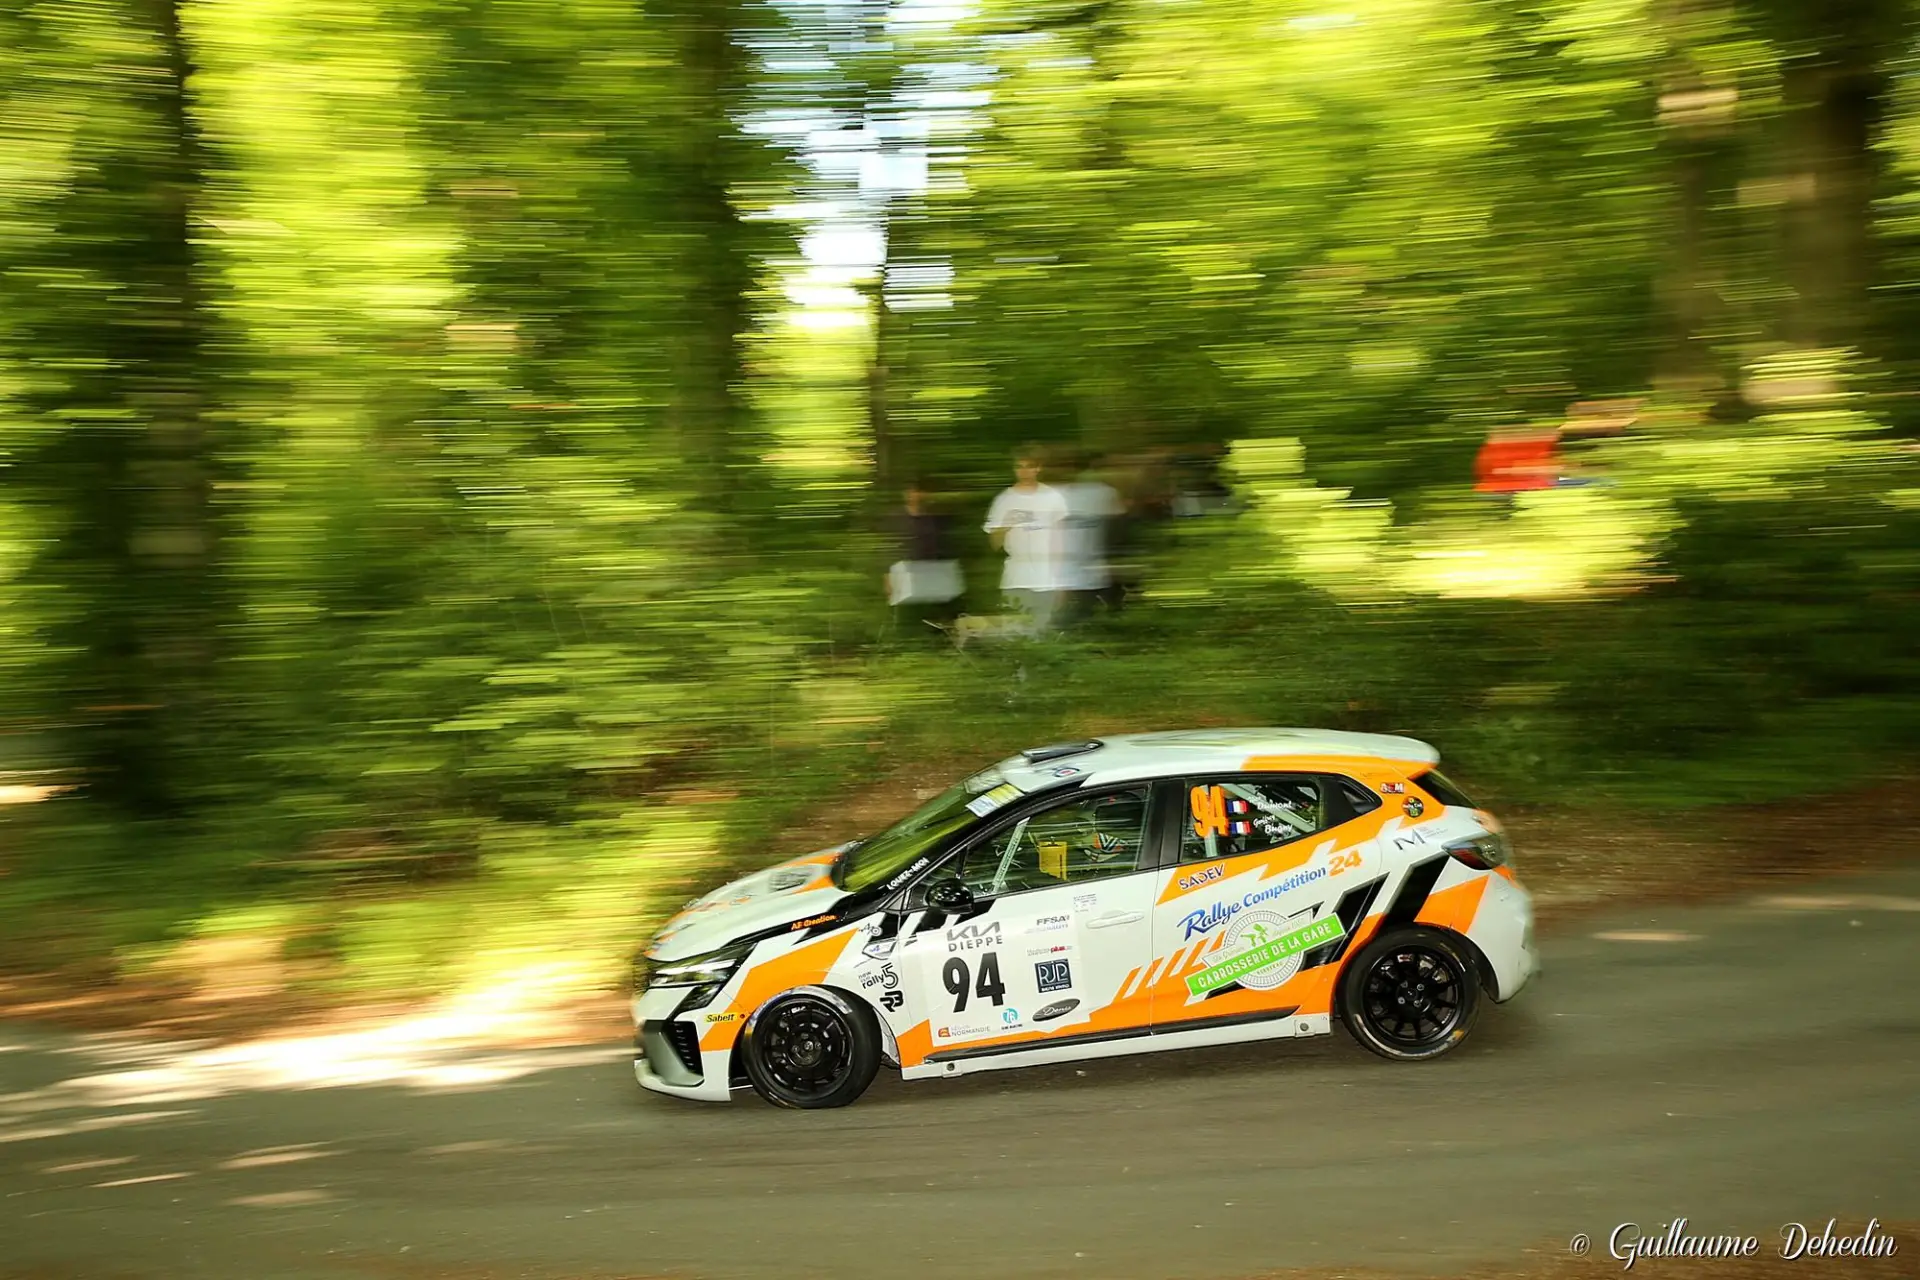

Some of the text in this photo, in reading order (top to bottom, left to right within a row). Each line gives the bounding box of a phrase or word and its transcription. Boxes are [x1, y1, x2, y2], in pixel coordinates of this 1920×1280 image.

[1190, 785, 1229, 838] 94
[1177, 901, 1242, 941] Rallye
[1243, 866, 1327, 907] Compétition
[1328, 849, 1363, 877] 24
[1178, 864, 1225, 889] SADEV
[948, 935, 1003, 952] DIEPPE
[1197, 949, 1270, 988] CARROSSERIE
[1270, 941, 1288, 956] DE
[1287, 937, 1301, 949] LA
[1301, 922, 1332, 942] GARE
[942, 952, 1006, 1013] 94
